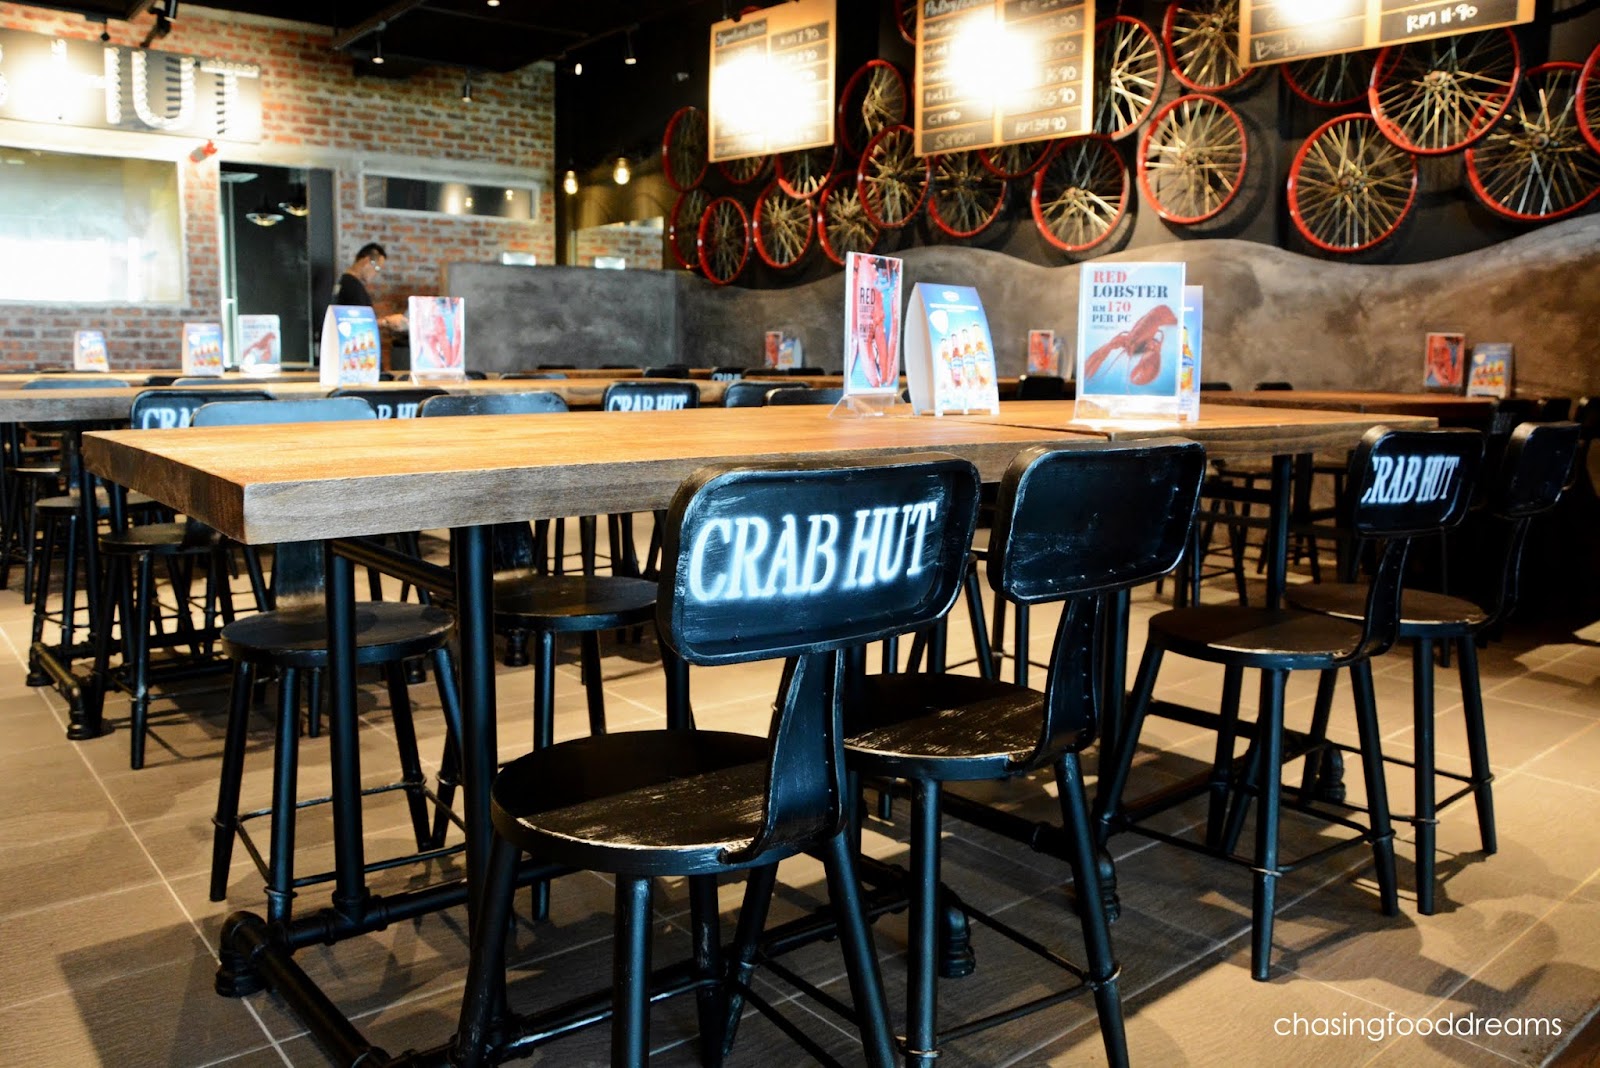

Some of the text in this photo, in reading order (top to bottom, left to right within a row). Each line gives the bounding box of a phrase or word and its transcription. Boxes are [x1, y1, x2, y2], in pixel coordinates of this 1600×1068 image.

[50, 38, 261, 137] HUT
[1093, 271, 1127, 283] RED
[860, 287, 876, 305] RED
[1092, 285, 1168, 298] LOBSTER
[1107, 301, 1131, 312] 170
[1092, 314, 1131, 323] PER PC
[142, 407, 198, 429] CRA
[1415, 455, 1460, 503] HUT
[688, 501, 938, 602] CRAB HUT
